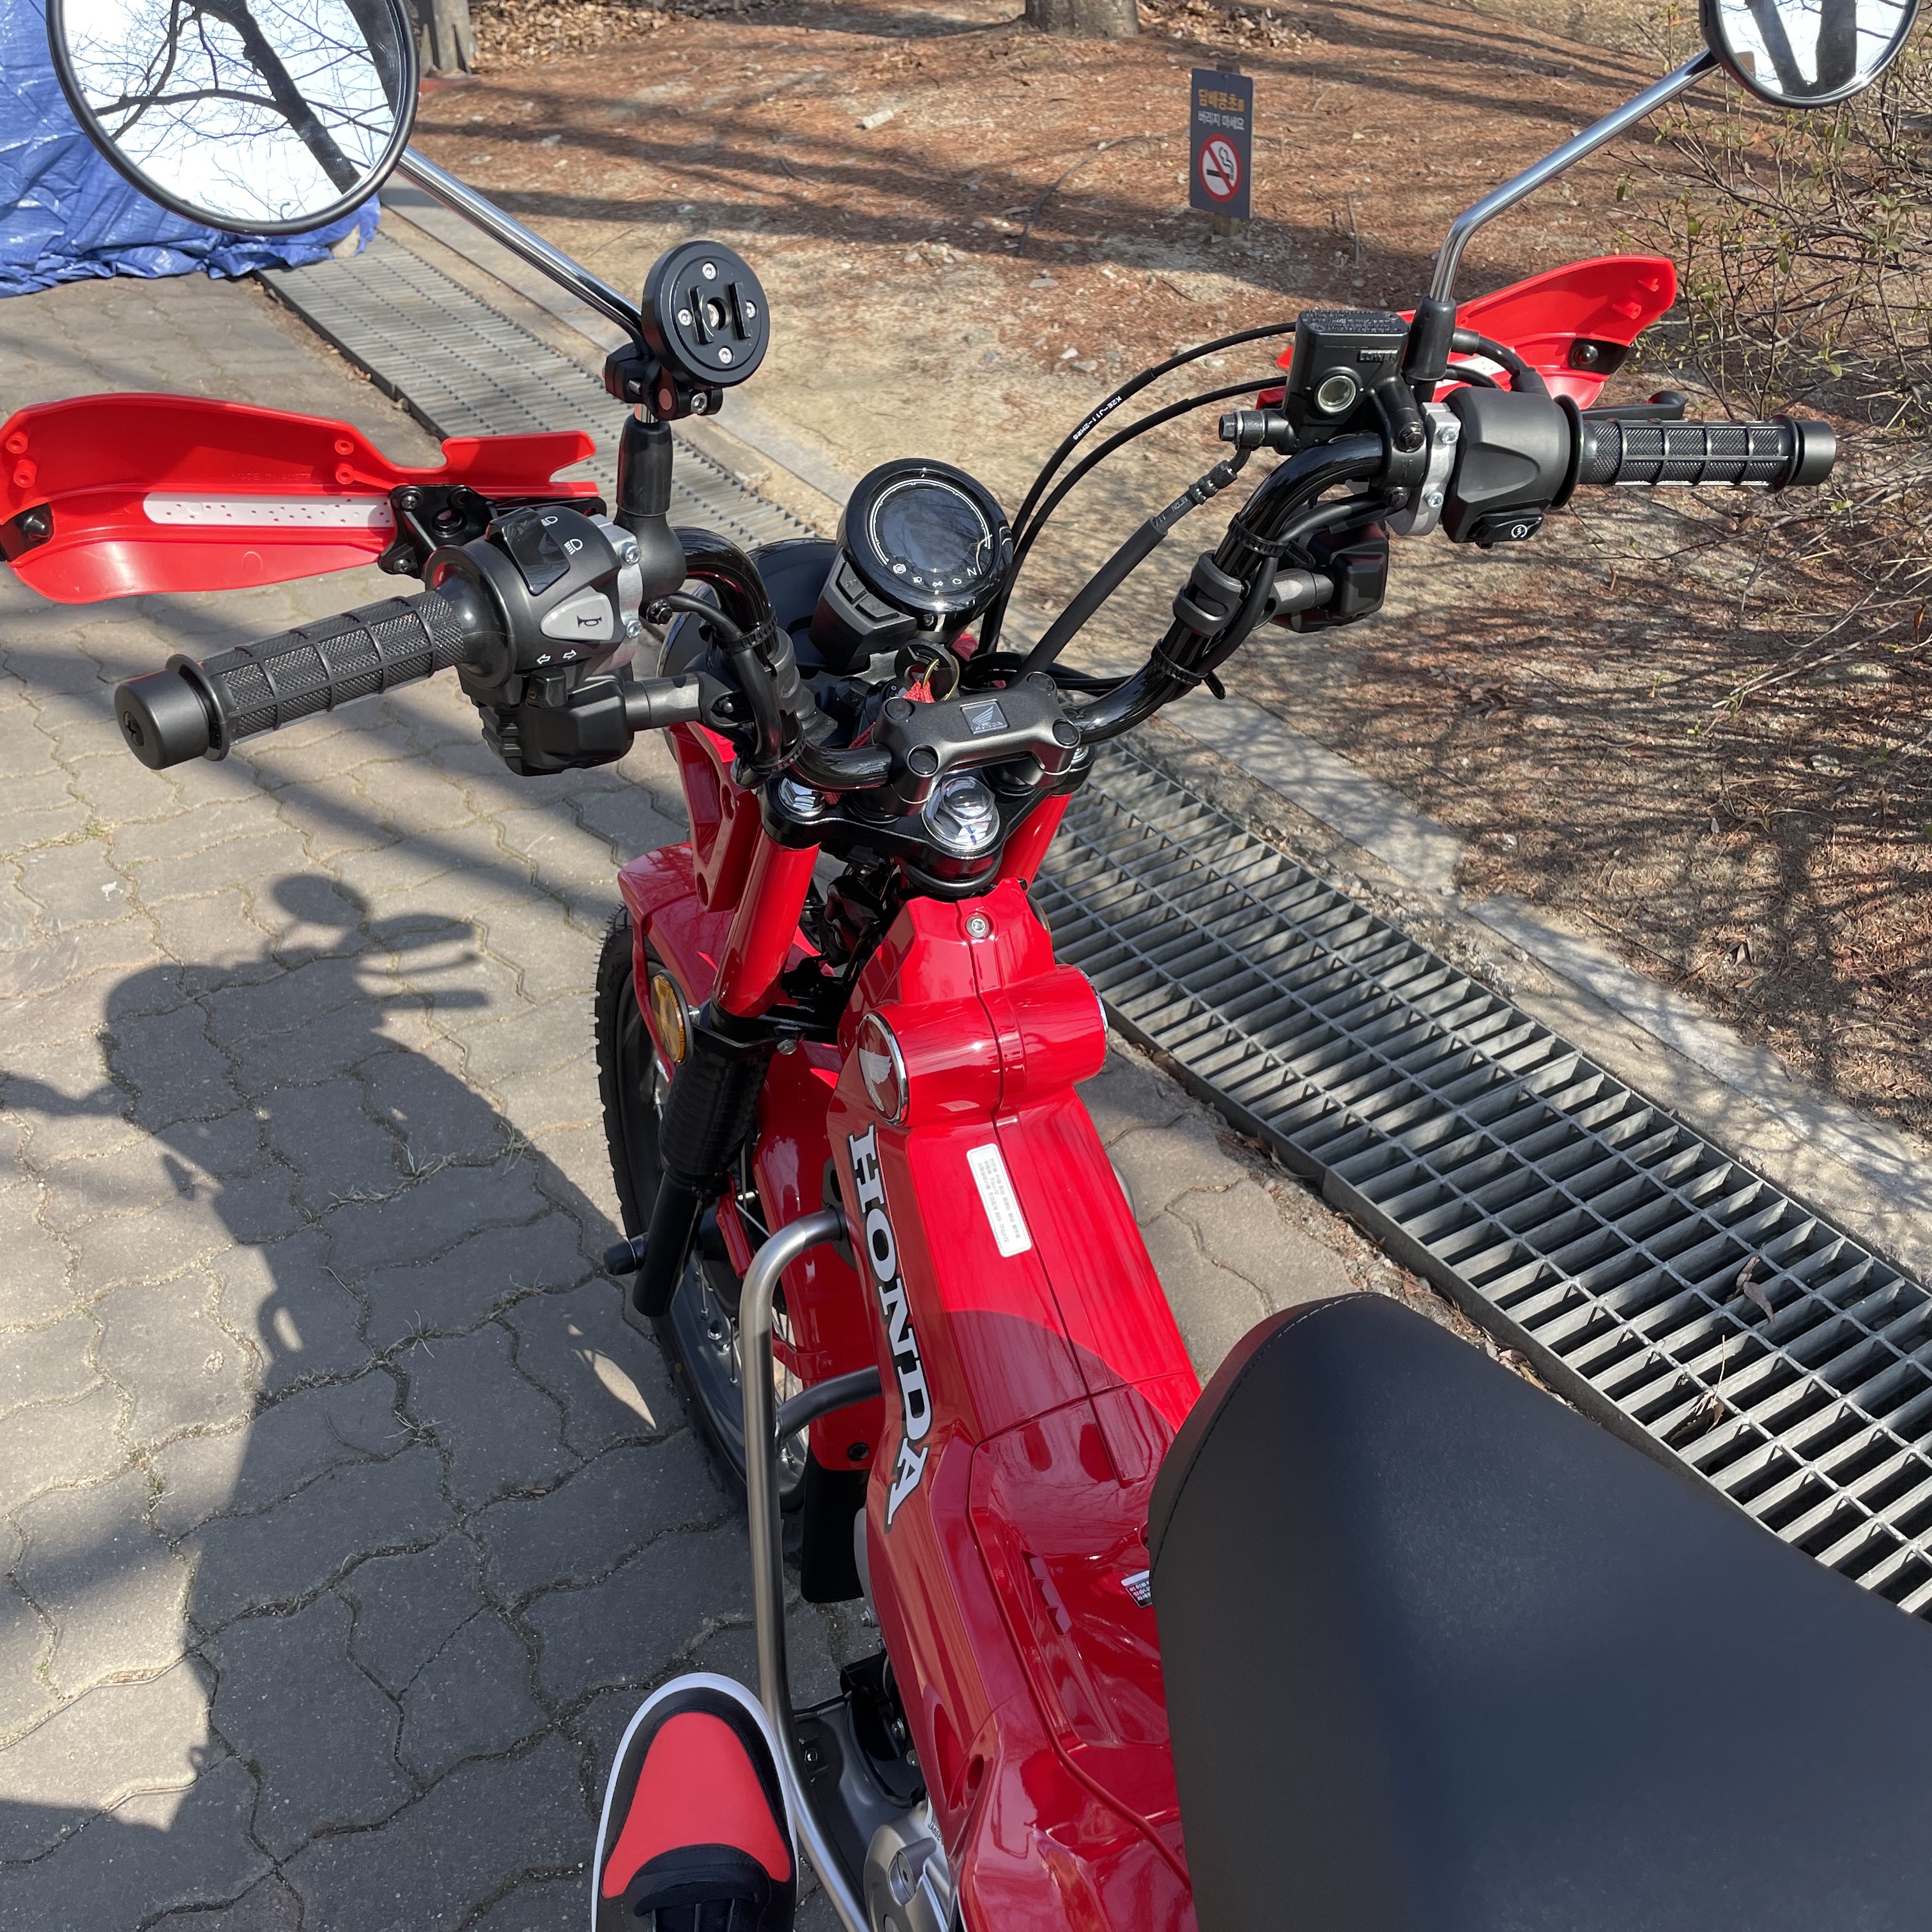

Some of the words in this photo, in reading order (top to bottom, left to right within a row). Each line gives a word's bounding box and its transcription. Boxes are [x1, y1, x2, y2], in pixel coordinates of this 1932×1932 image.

[1198, 111, 1220, 128] 버리지
[1222, 114, 1245, 130] 마세요
[967, 567, 977, 577] N
[848, 1124, 933, 1526] HONDA
